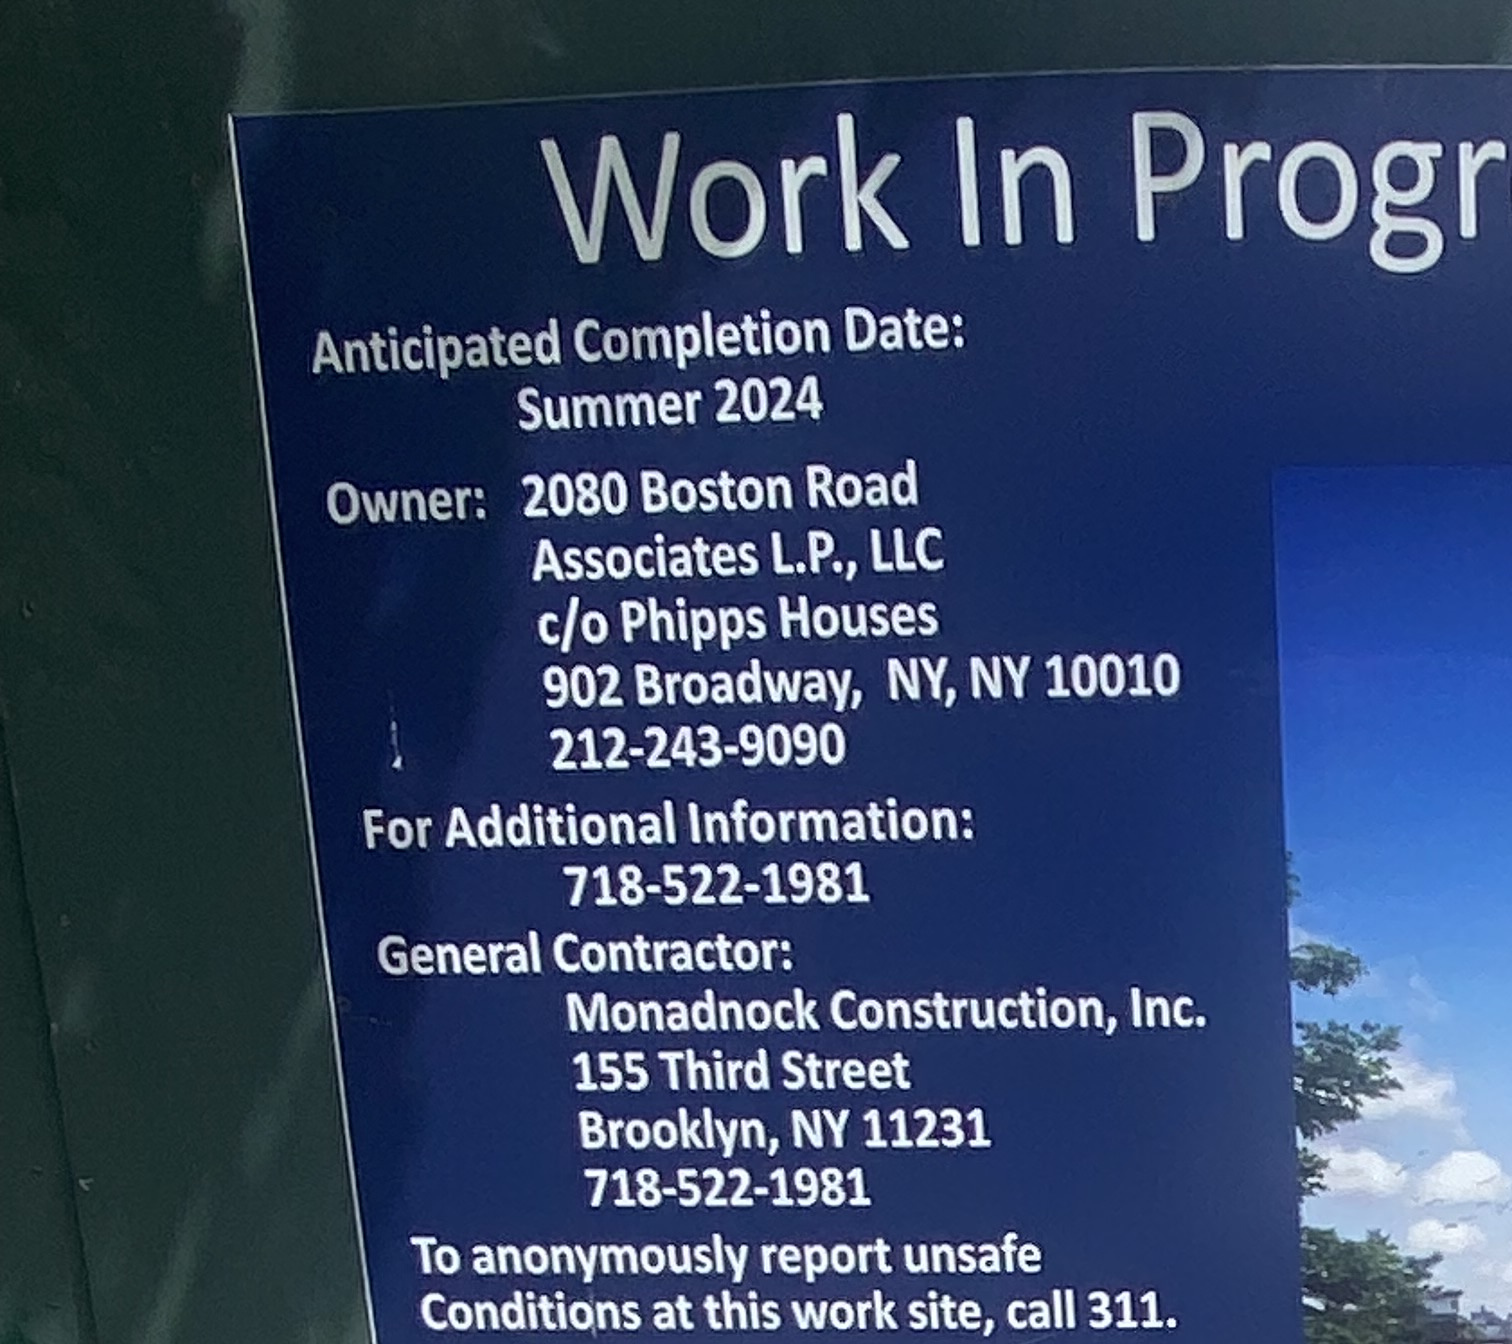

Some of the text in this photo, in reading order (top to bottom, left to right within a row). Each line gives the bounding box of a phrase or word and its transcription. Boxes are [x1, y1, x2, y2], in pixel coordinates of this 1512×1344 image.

[540, 113, 909, 264] Work
[956, 116, 1074, 247] In
[312, 306, 964, 380] Anticipated Completion Date:
[517, 375, 824, 431] Summer 2024
[327, 458, 918, 525] Owner: 2080 Boston Road
[532, 526, 944, 582] Associates L.P., LLC
[537, 595, 939, 653] c/o Phipps Houses
[542, 652, 1180, 713] 902 Broadway, NY, NY 10010
[550, 721, 846, 771] 212-243-9090
[363, 797, 974, 849] For Additional Information:
[562, 861, 870, 907] 718-522-1981
[377, 930, 793, 975] General Contractor:
[565, 986, 1206, 1036] Monadnock Construction, Inc.
[572, 1048, 911, 1093] 155 Third Street
[578, 1107, 992, 1158] Brooklyn, NY 11231
[583, 1167, 872, 1207] 718-522-1981
[410, 1232, 1041, 1287] To anonymously report unsafe
[421, 1288, 1177, 1337] Conditions at this work site, call 311.
